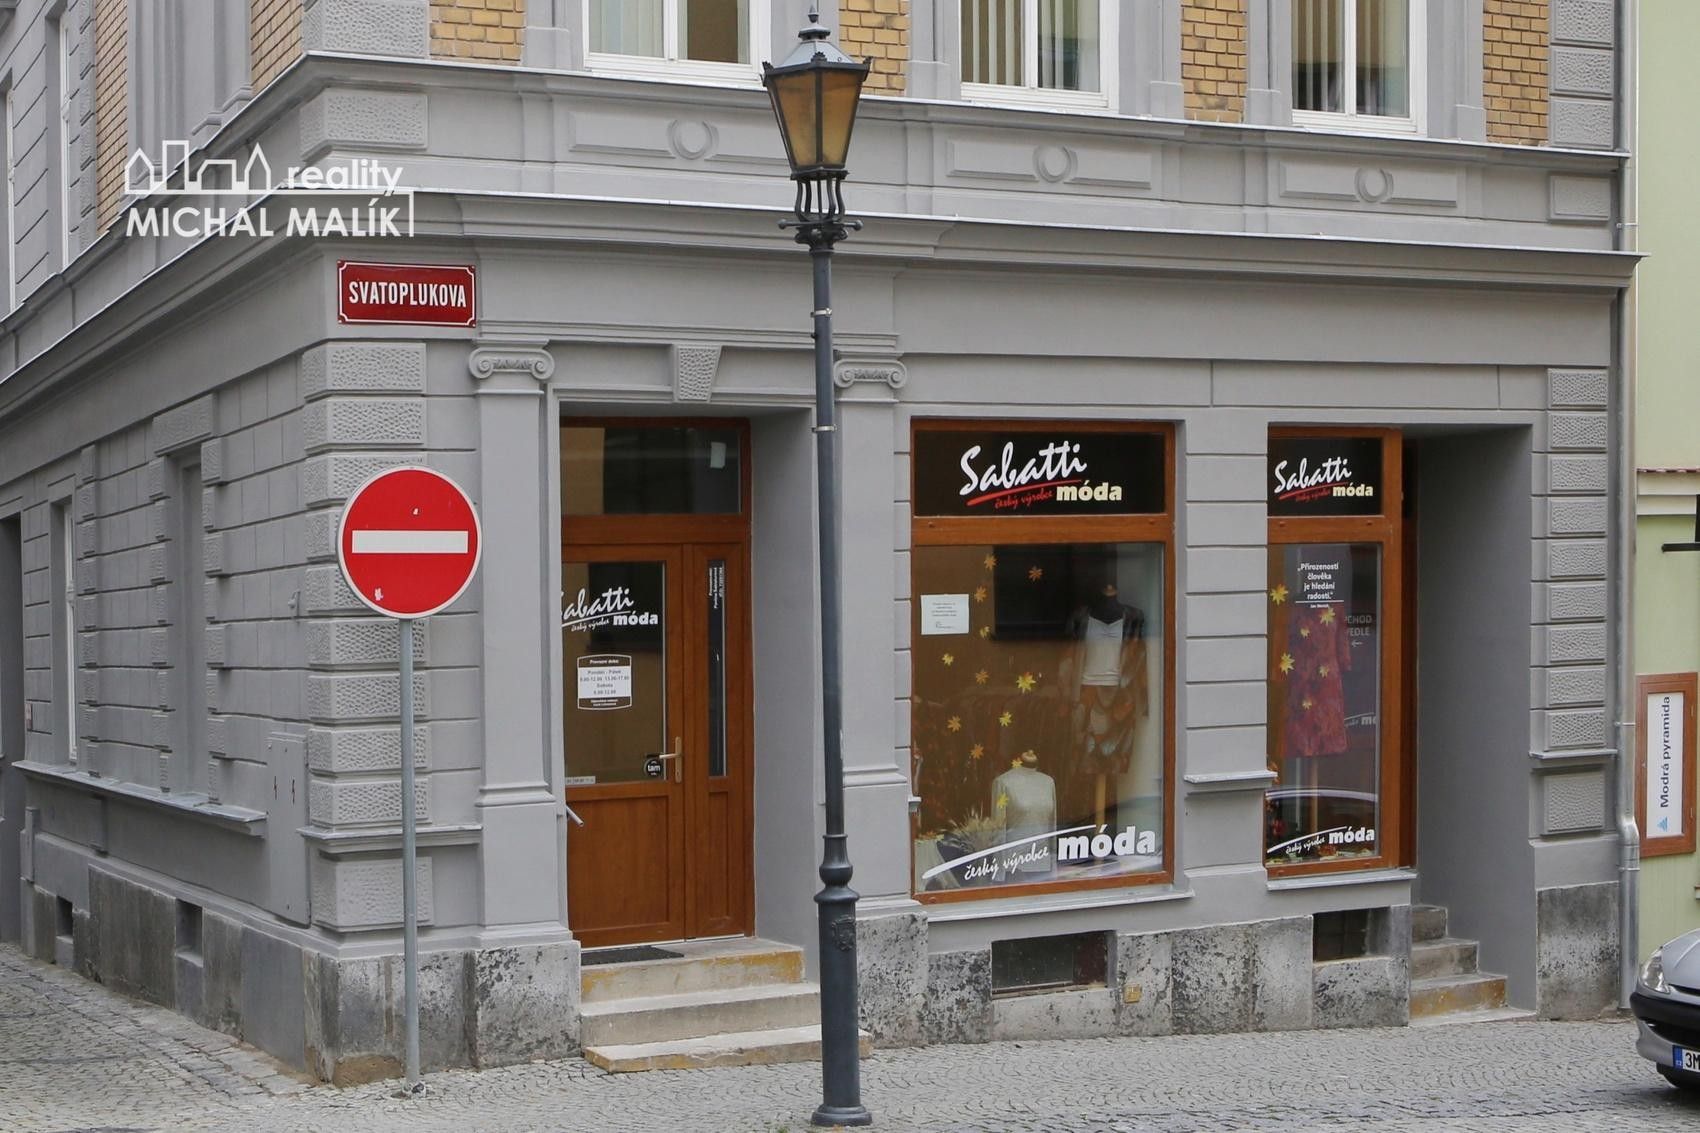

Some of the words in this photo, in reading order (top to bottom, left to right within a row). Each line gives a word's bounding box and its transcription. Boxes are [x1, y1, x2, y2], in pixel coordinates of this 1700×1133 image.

[348, 281, 467, 308] SVATOPLUKOVA
[959, 440, 1088, 496] Sabatti
[1274, 456, 1352, 494] Sabatti
[1056, 480, 1123, 501] móda
[1332, 483, 1374, 497] móda
[561, 586, 634, 620] abatti
[613, 610, 659, 626] móda
[1344, 614, 1373, 625] CHOD
[1660, 696, 1672, 762] pyramida
[1660, 762, 1671, 809] Modrá
[1328, 825, 1376, 845] móda
[963, 857, 1000, 881] český
[1002, 842, 1049, 875] výrobce
[1057, 823, 1156, 861] móda
